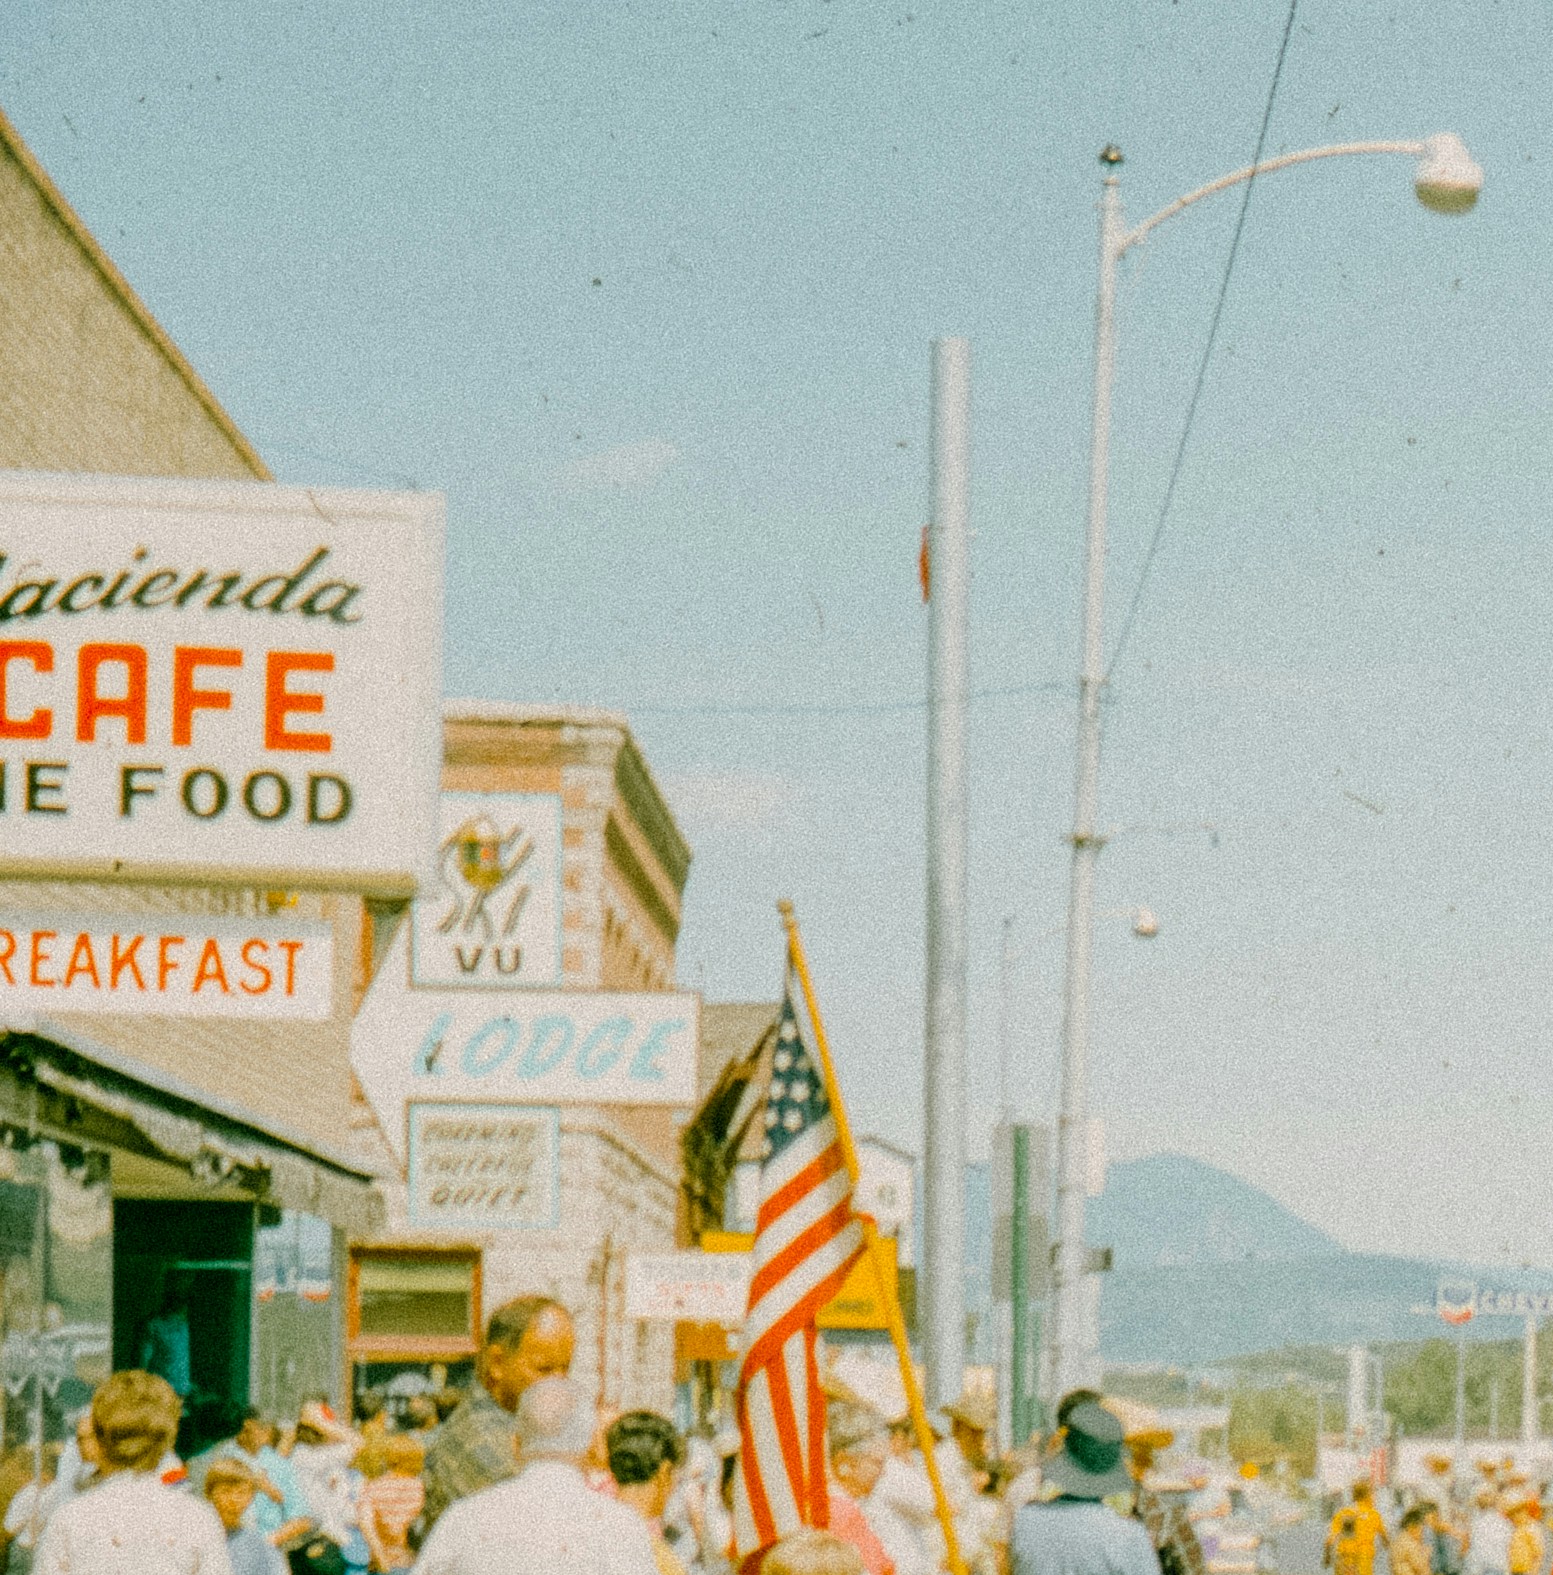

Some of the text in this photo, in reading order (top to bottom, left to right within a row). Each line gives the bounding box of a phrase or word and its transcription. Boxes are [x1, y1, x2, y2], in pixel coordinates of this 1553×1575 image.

[0, 543, 362, 625] acienda
[0, 638, 336, 753] CAFE
[118, 763, 353, 826] FOOD
[454, 944, 521, 973] VU
[411, 1011, 688, 1080] LODGE
